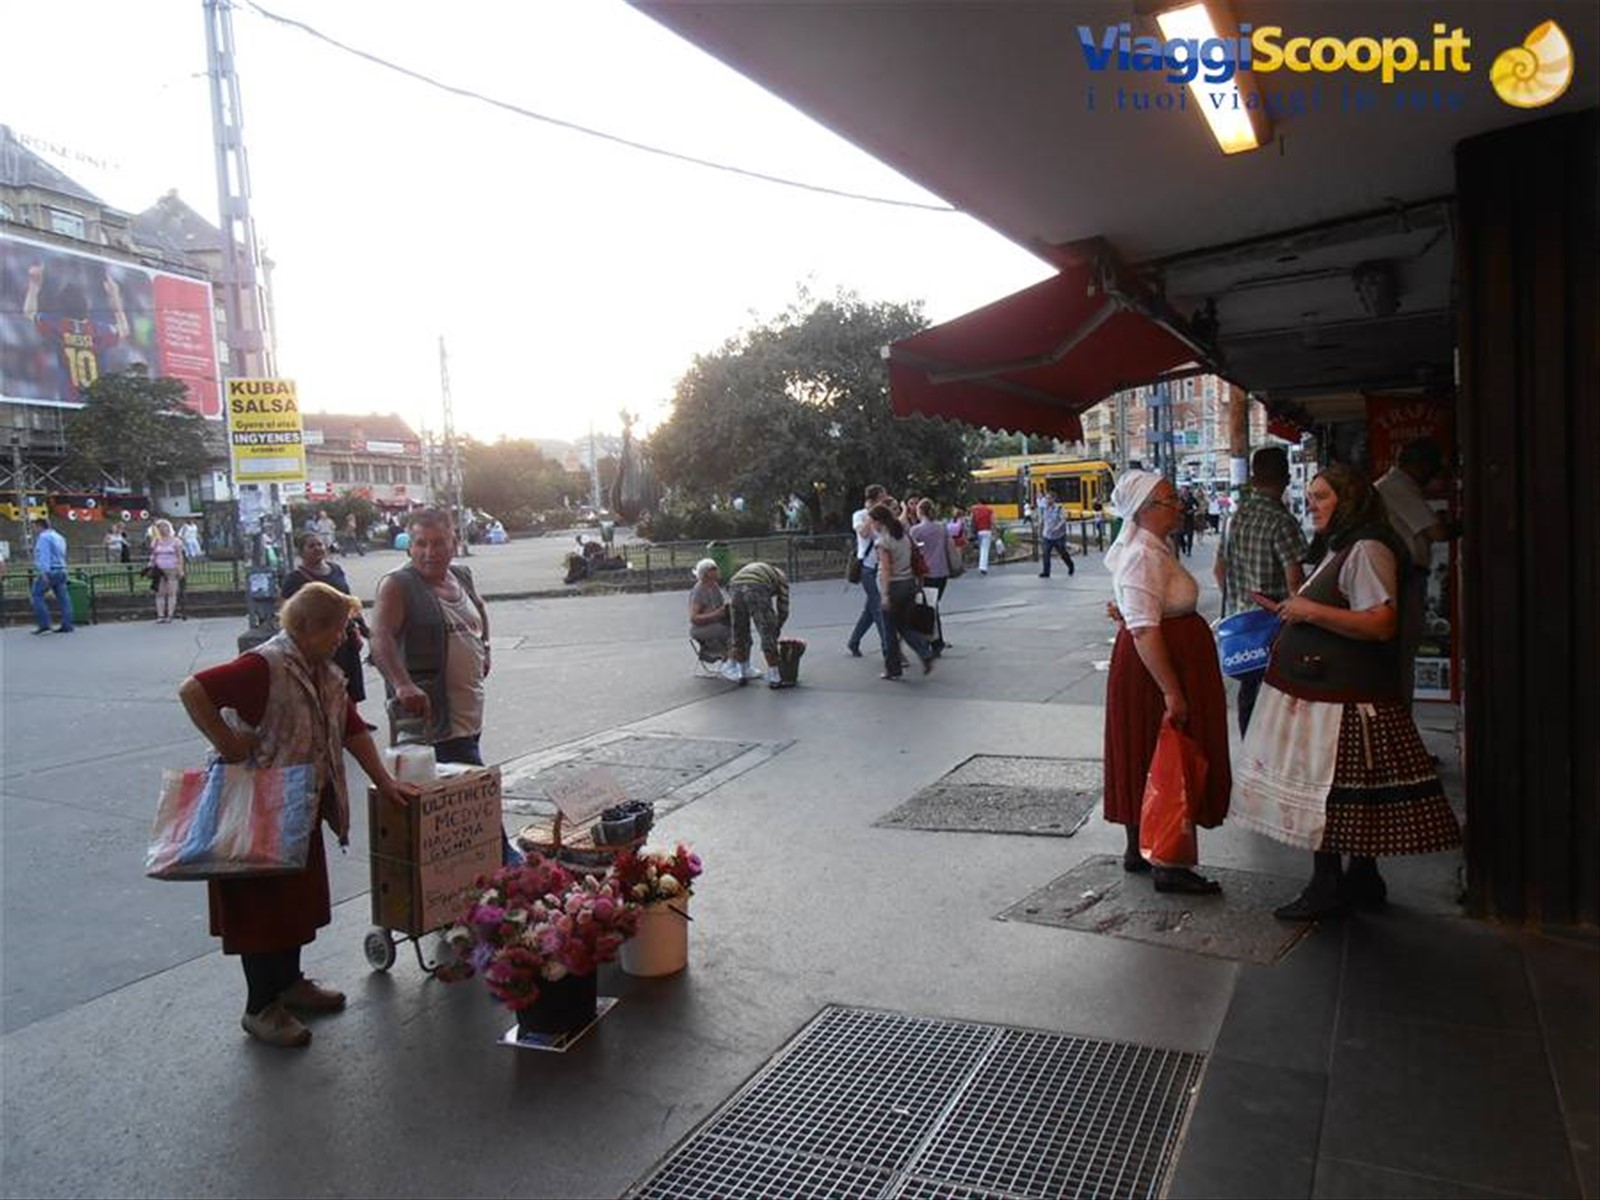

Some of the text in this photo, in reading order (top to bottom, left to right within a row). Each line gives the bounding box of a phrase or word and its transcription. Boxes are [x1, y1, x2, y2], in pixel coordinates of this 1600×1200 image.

[64, 347, 98, 388] 10
[231, 399, 298, 414] SALSA
[233, 432, 301, 444] INGYENES
